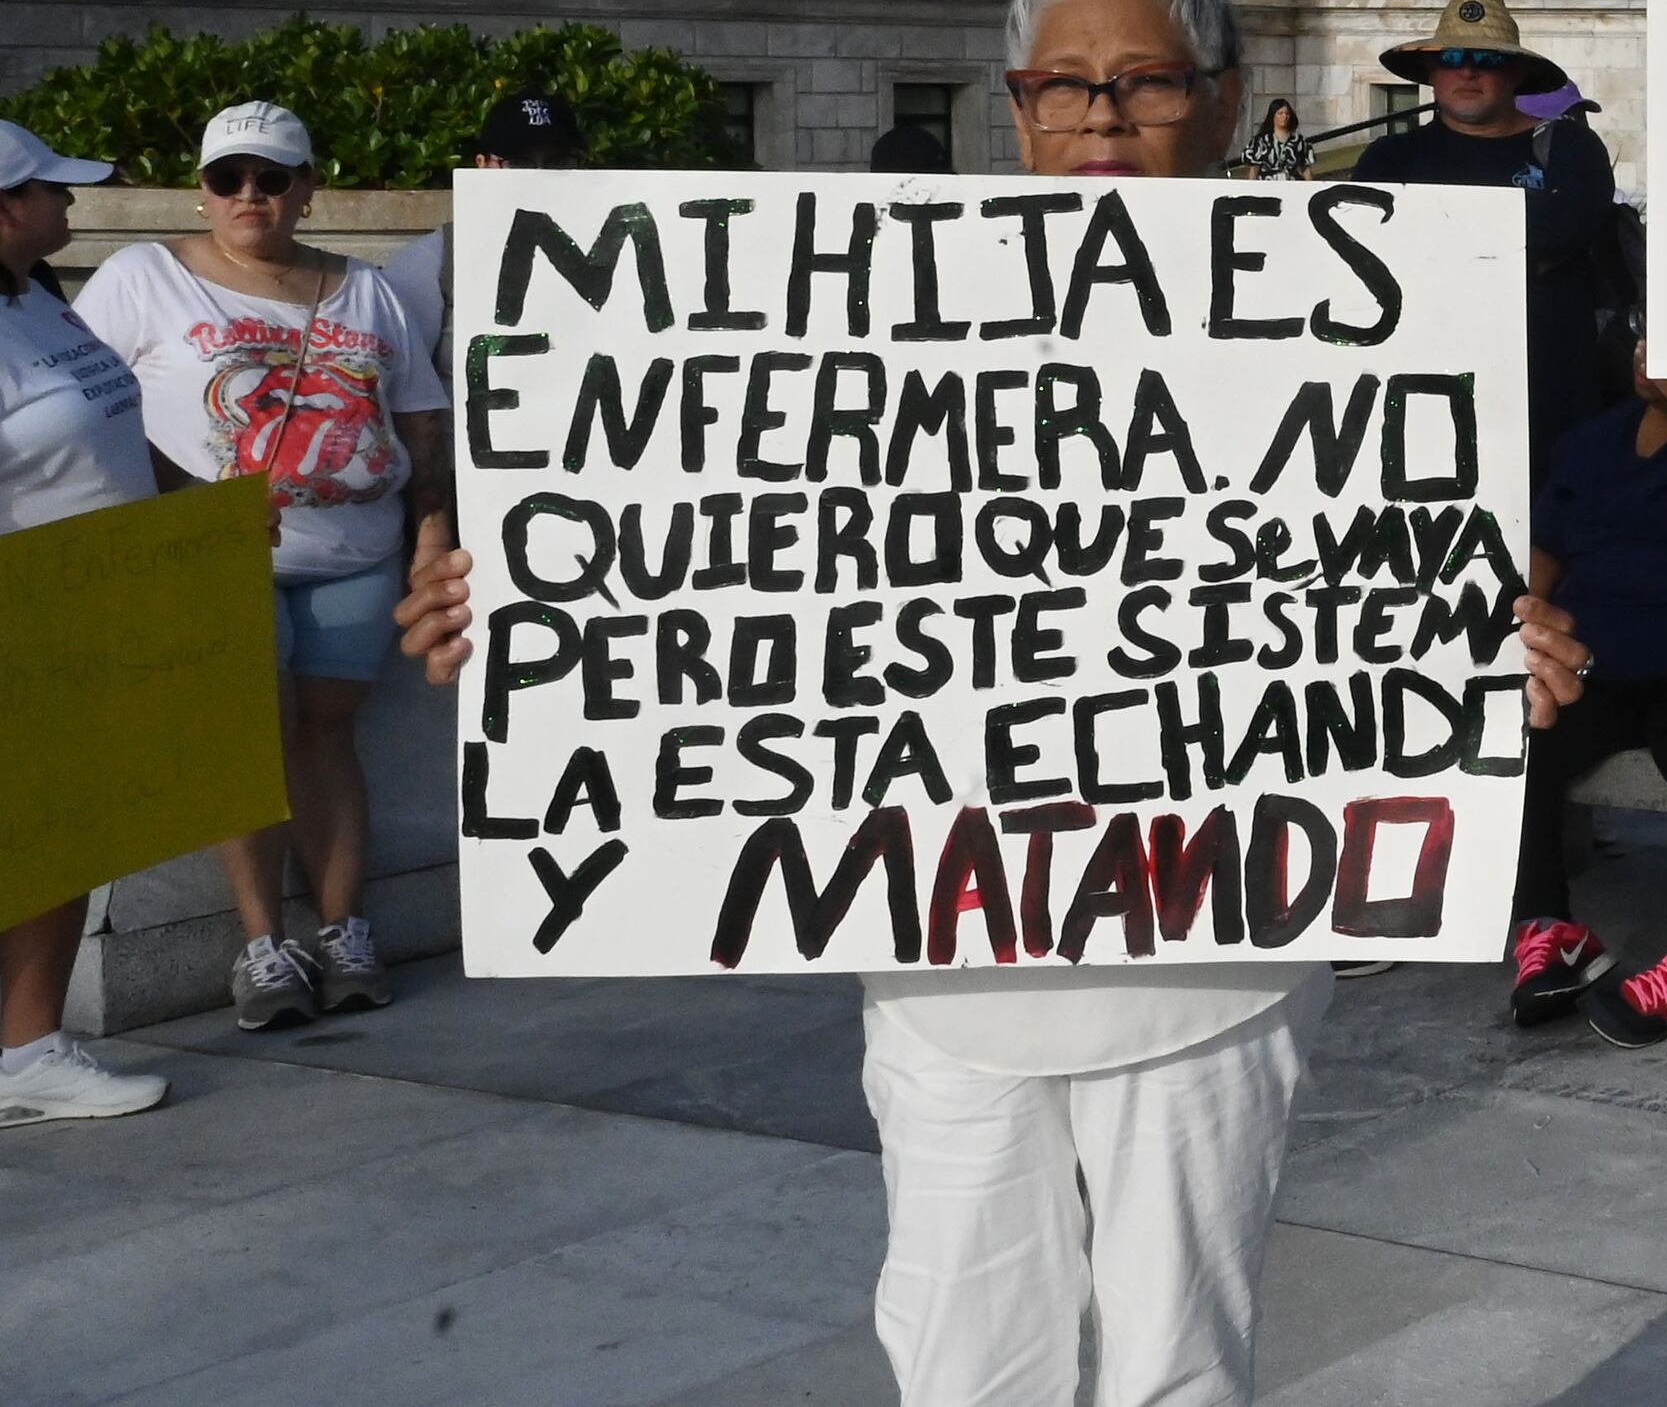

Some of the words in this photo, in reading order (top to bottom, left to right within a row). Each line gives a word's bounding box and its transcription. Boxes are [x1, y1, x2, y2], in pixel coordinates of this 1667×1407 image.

[496, 197, 768, 334] MI
[785, 188, 1173, 342] HIJA
[1206, 182, 1403, 348] ES
[1249, 370, 1478, 505] NO
[501, 488, 965, 610] QUIERO
[974, 495, 1186, 591] QUE
[483, 600, 798, 743] PERO
[821, 586, 1092, 709] ESTE
[462, 740, 623, 841] LA
[652, 710, 955, 818] ESTA
[984, 666, 1531, 808] ECHANDO
[526, 838, 629, 954] Y
[709, 792, 1455, 970] MATANDO
